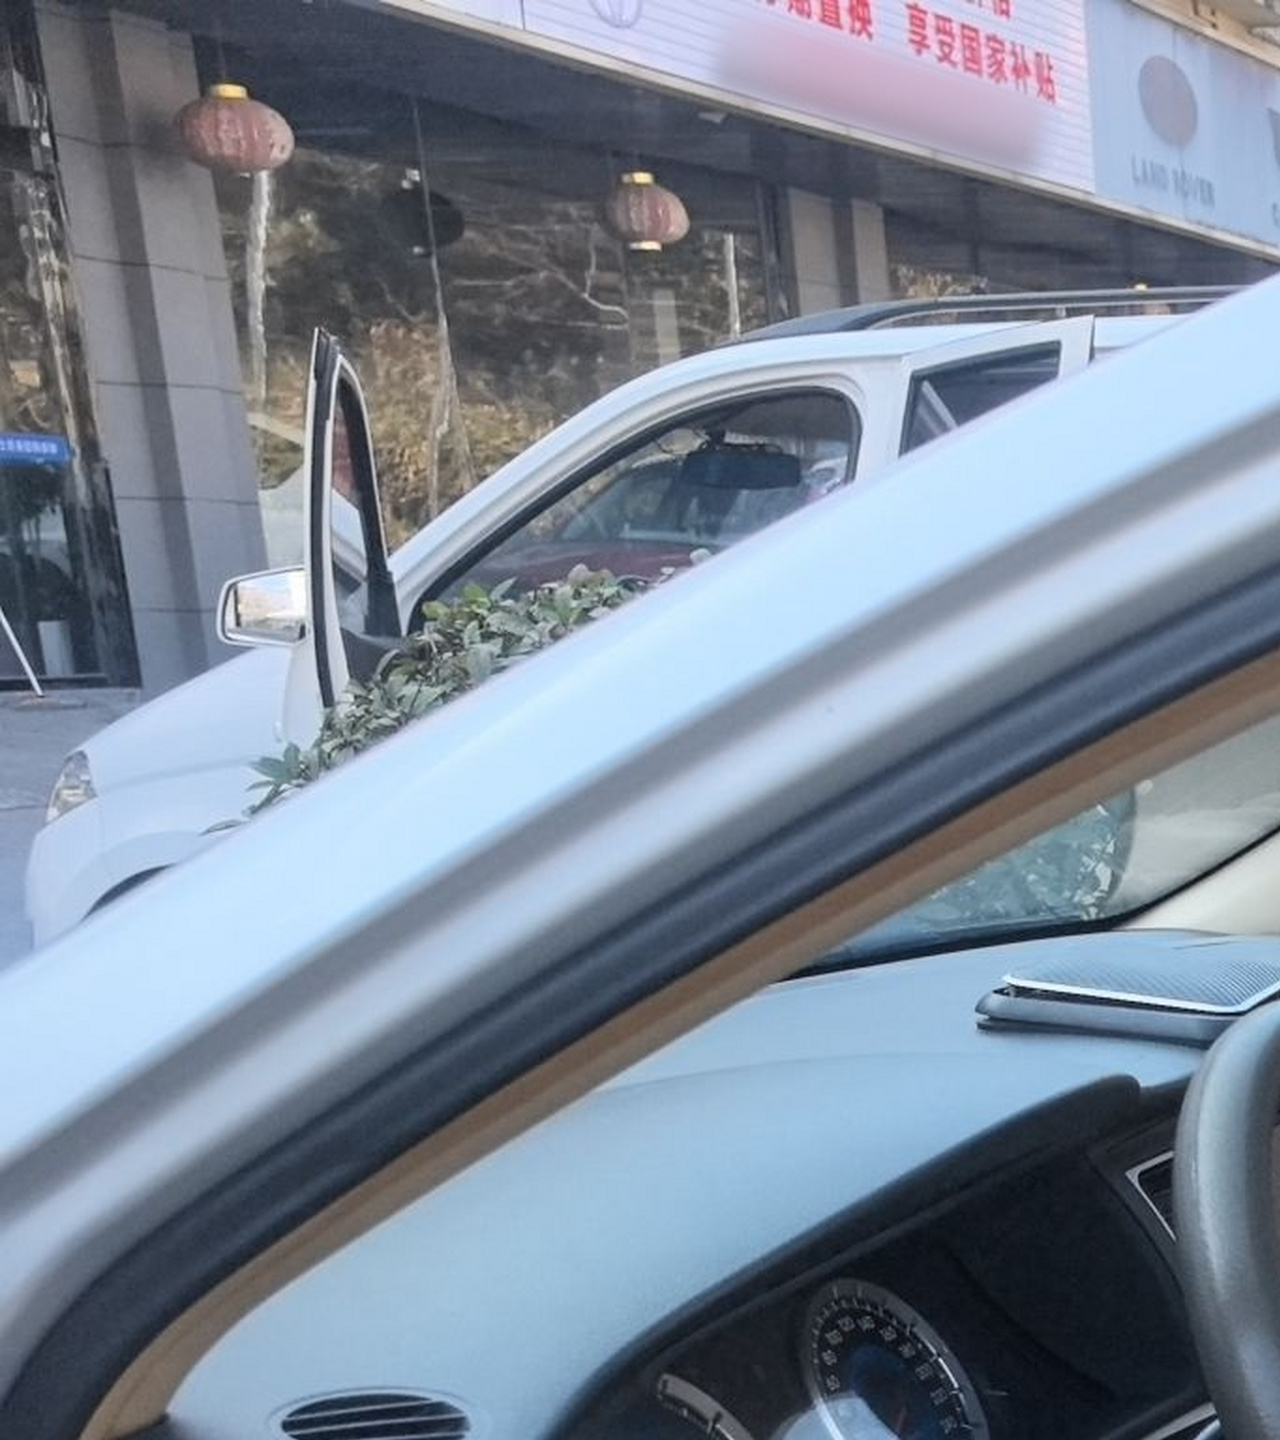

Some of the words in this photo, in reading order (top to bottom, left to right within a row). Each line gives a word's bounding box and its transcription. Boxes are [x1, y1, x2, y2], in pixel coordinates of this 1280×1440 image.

[905, 3, 1057, 104] 享受国家补贴
[1131, 152, 1168, 191] LAND
